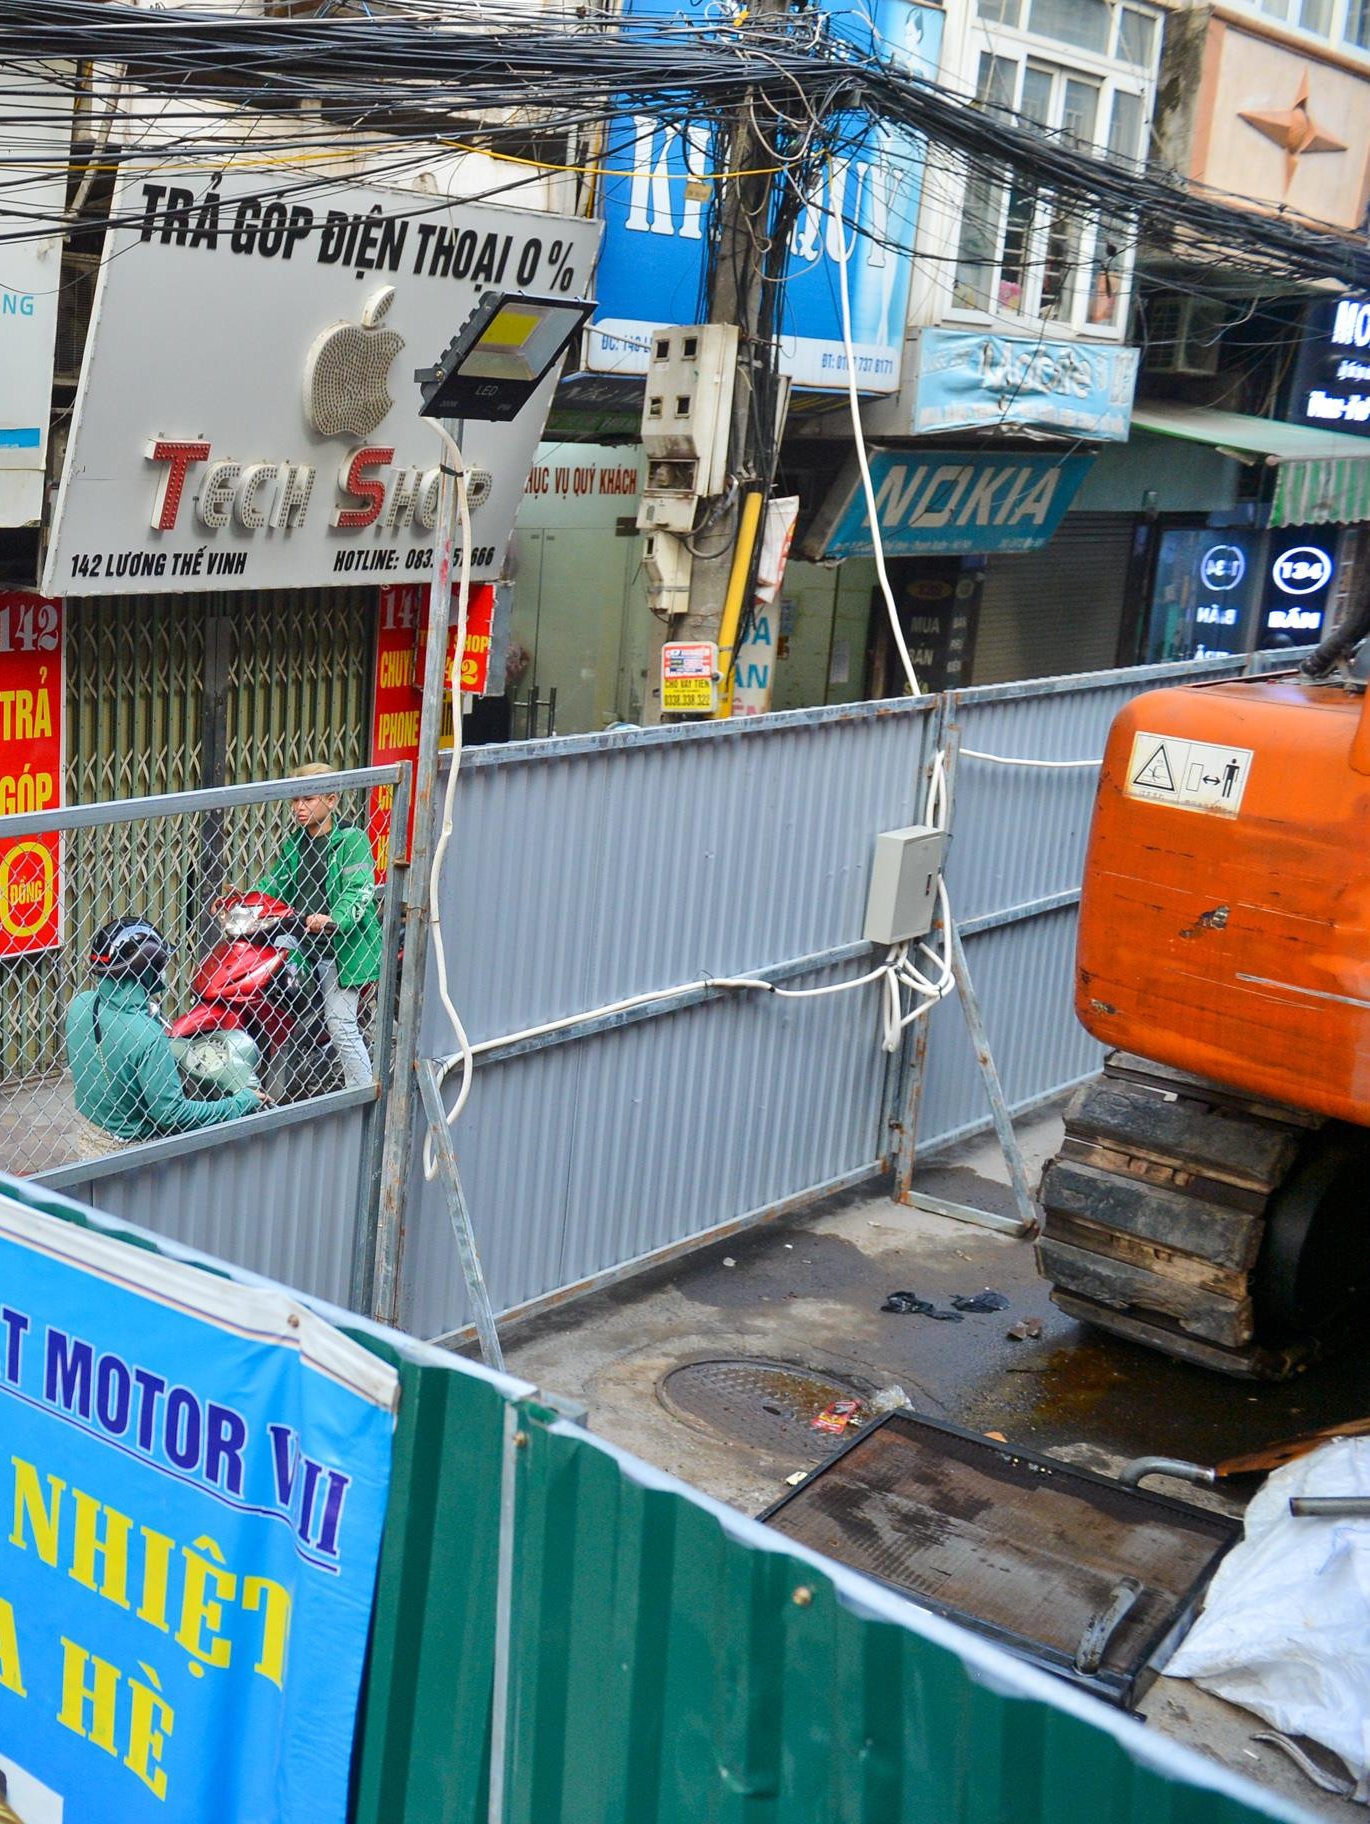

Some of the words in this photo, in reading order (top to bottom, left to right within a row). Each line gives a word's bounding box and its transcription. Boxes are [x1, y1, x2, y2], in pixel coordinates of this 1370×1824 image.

[141, 171, 222, 250] TRẢ
[230, 192, 314, 260] GÓP
[318, 204, 410, 280] ĐIỆN
[413, 222, 515, 293] THOẠI
[516, 238, 542, 287] 0
[548, 239, 575, 293] %
[1332, 300, 1370, 347] MO
[474, 385, 498, 396] LED
[525, 466, 549, 499] HỤC
[555, 467, 570, 500] VỤ
[573, 462, 596, 497] QUÝ
[599, 463, 637, 495] KHÁCH
[861, 464, 1061, 528] NOKIA
[71, 553, 103, 577] 142
[105, 551, 168, 577] LƯƠNG
[171, 545, 208, 576] THẾ
[206, 552, 248, 576] VINH
[333, 549, 400, 572] HOTLINE:
[1281, 561, 1323, 580] 134
[382, 589, 416, 630] 14
[0, 666, 52, 741] TRẢ
[378, 710, 420, 750] IPHONE
[10, 876, 43, 905] ĐỒNG
[45, 1333, 246, 1500] MOTOR
[8, 1455, 293, 1692] NHIỆT
[56, 1635, 176, 1803] HÈ
